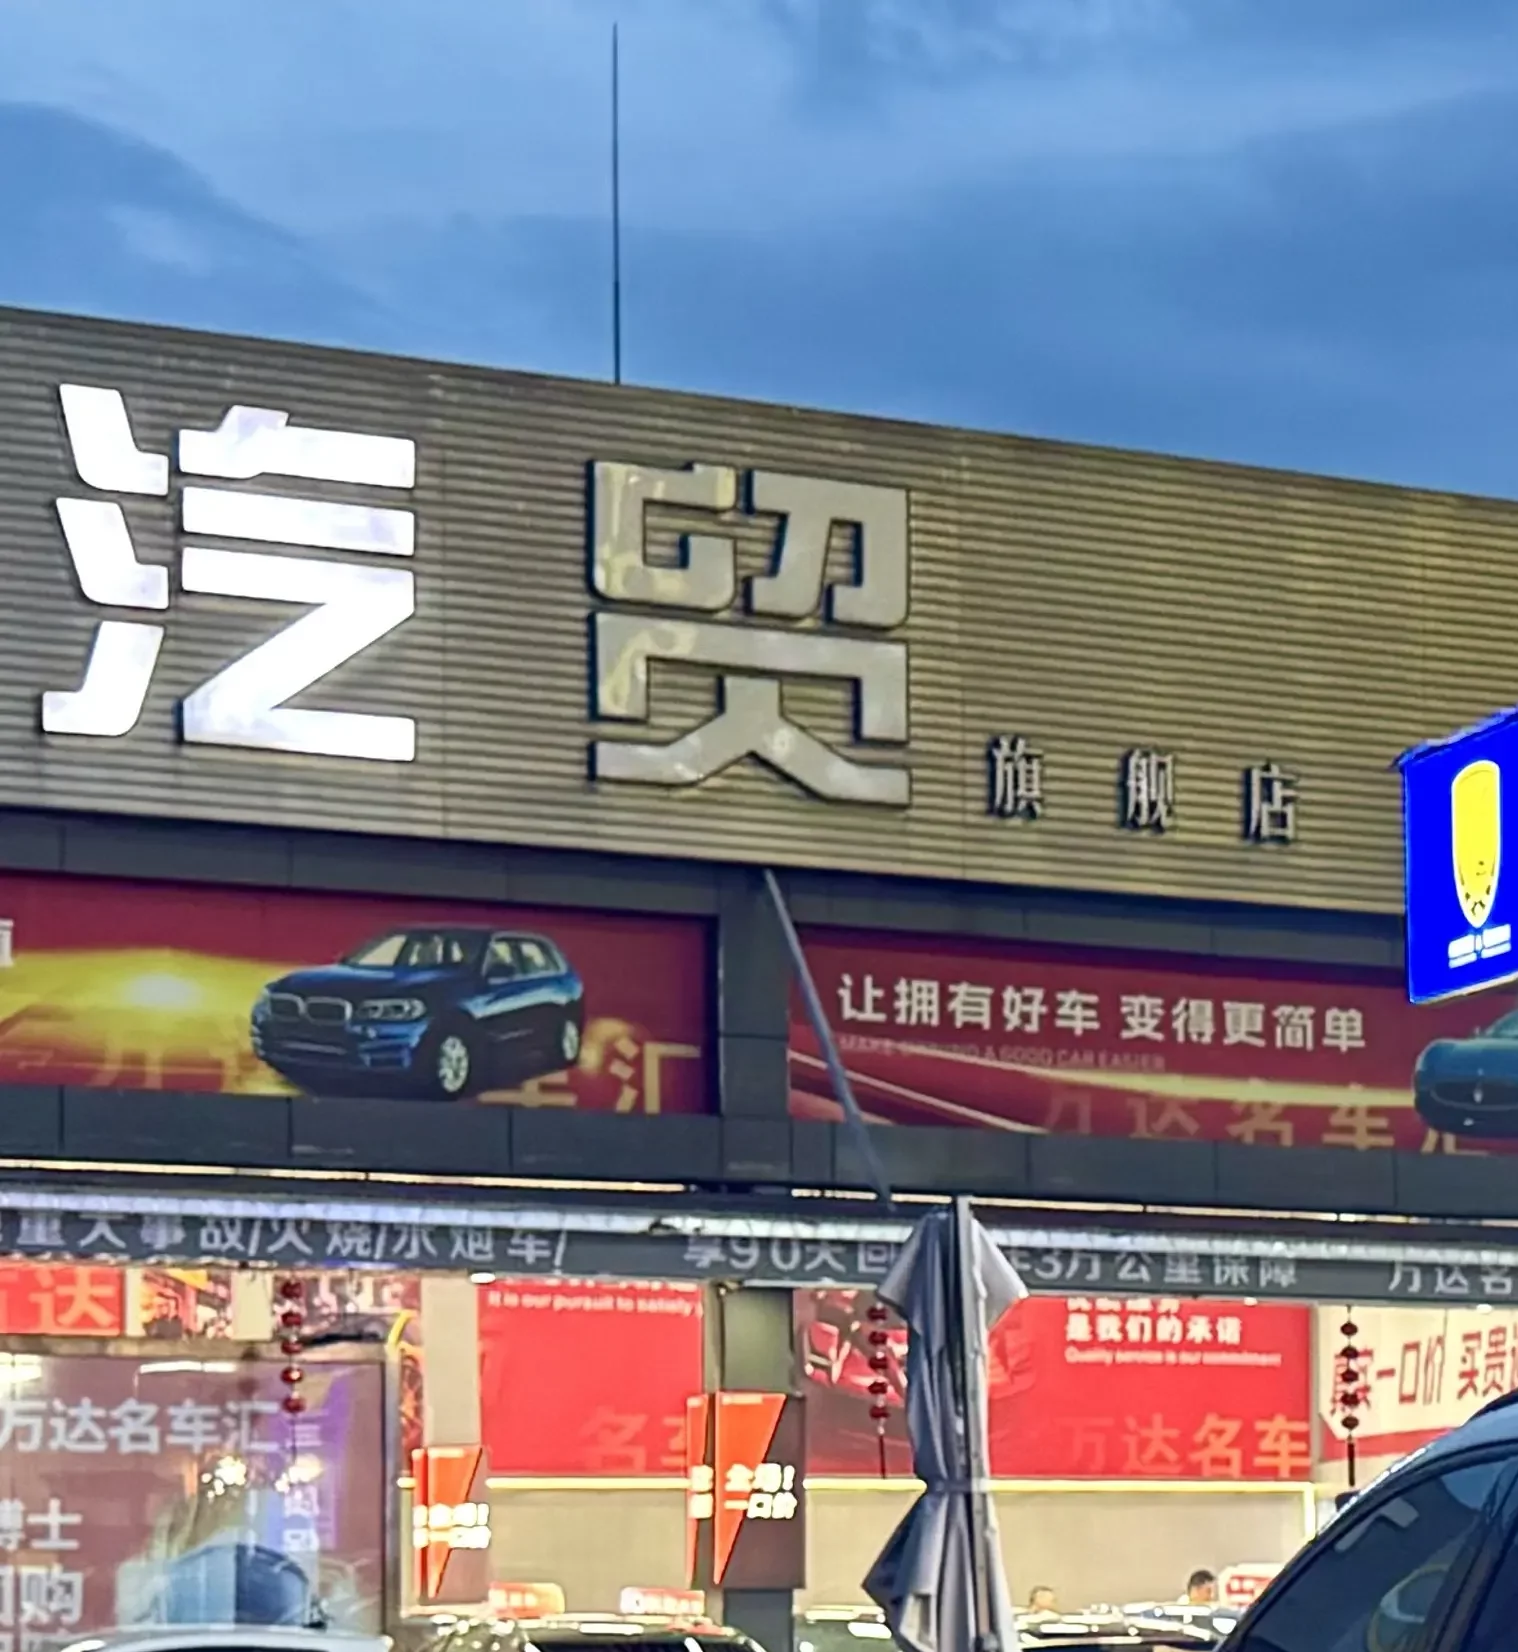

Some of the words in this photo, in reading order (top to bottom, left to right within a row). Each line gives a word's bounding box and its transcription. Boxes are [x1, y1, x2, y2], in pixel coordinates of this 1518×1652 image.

[42, 382, 912, 807] 汽贸
[990, 734, 1299, 842] 旗舰店
[837, 973, 1100, 1036] 让拥有好车
[1120, 994, 1366, 1053] 变得更简单
[1065, 1311, 1242, 1346] 是我们的承诺
[0, 1396, 281, 1454] 万达名车汇
[1052, 1412, 1312, 1479] 万达名车
